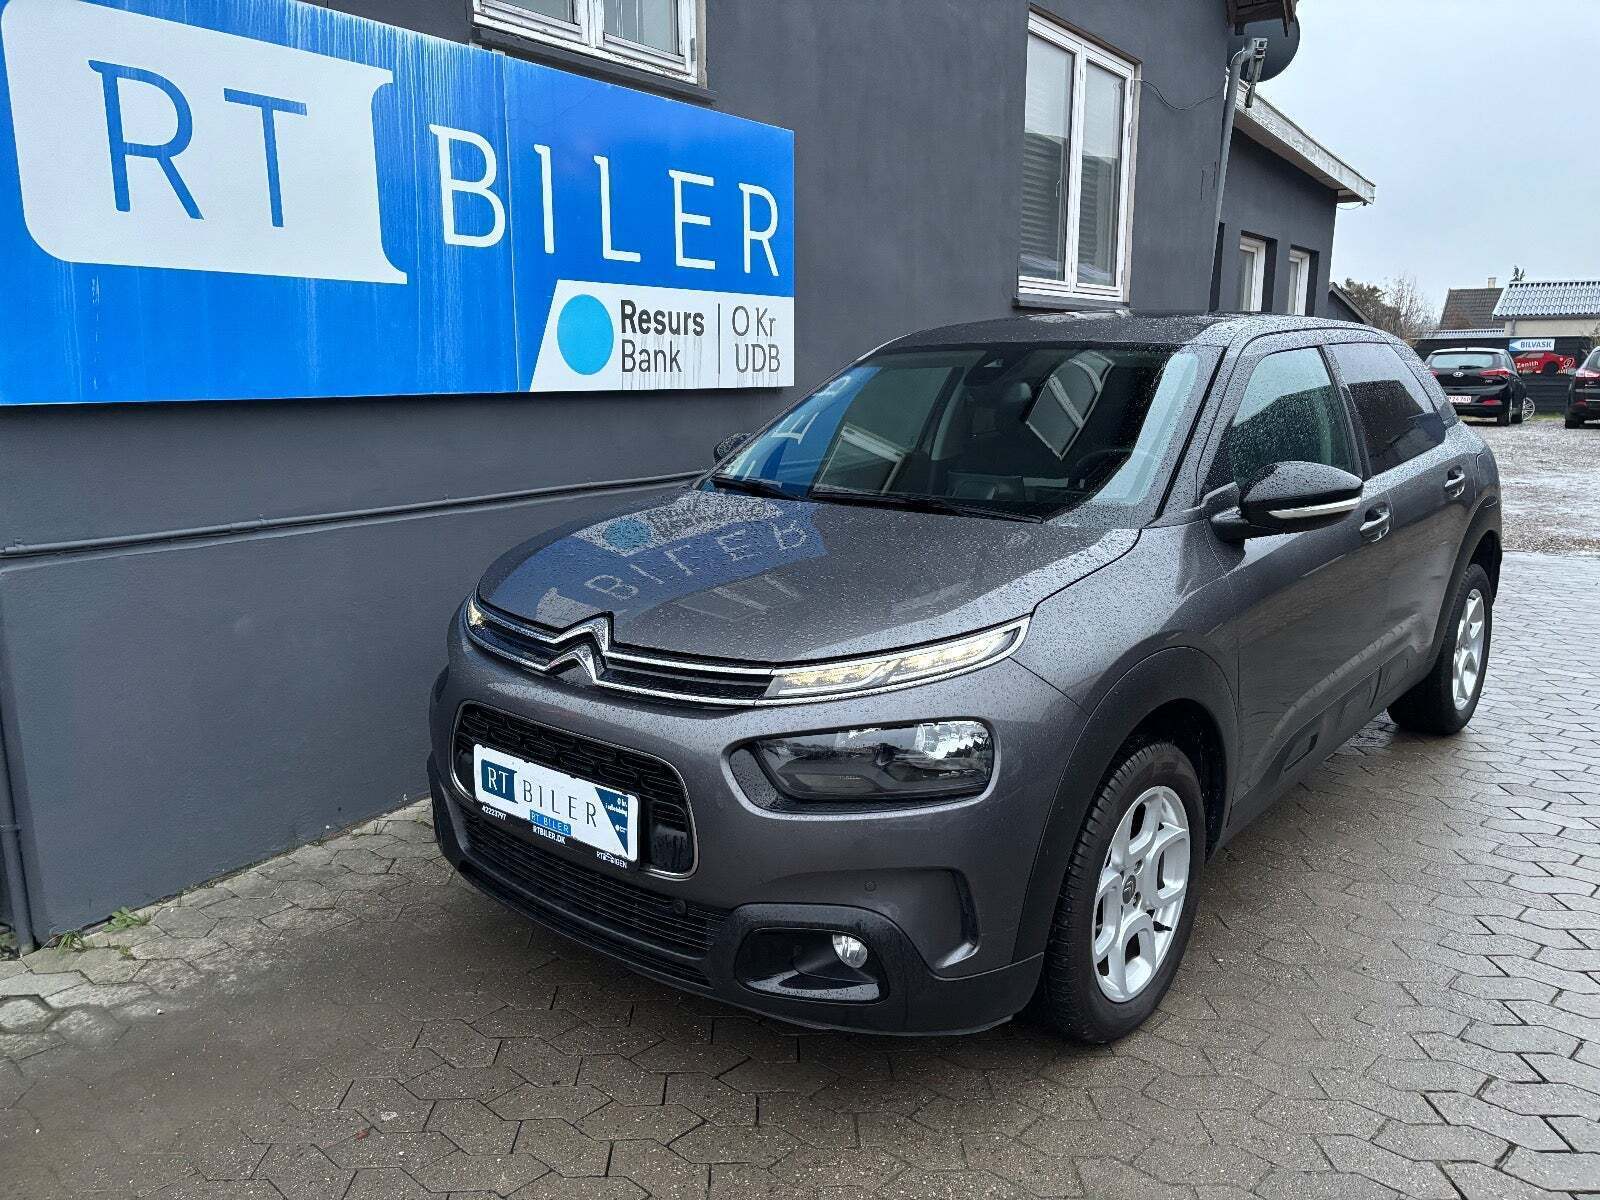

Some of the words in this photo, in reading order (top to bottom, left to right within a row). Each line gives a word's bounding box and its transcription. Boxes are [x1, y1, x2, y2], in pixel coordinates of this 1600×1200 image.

[87, 58, 308, 229] RT
[429, 123, 780, 277] BILER
[620, 299, 705, 337] Resurs
[755, 306, 777, 338] Kr
[621, 338, 683, 373] Bank
[735, 343, 781, 374] UDB
[1516, 360, 1539, 369] Zenith
[487, 766, 510, 794] RT
[522, 779, 597, 828] BILER
[531, 812, 540, 822] RT
[543, 815, 570, 834] BILER
[532, 824, 566, 845] RTBILER.DK
